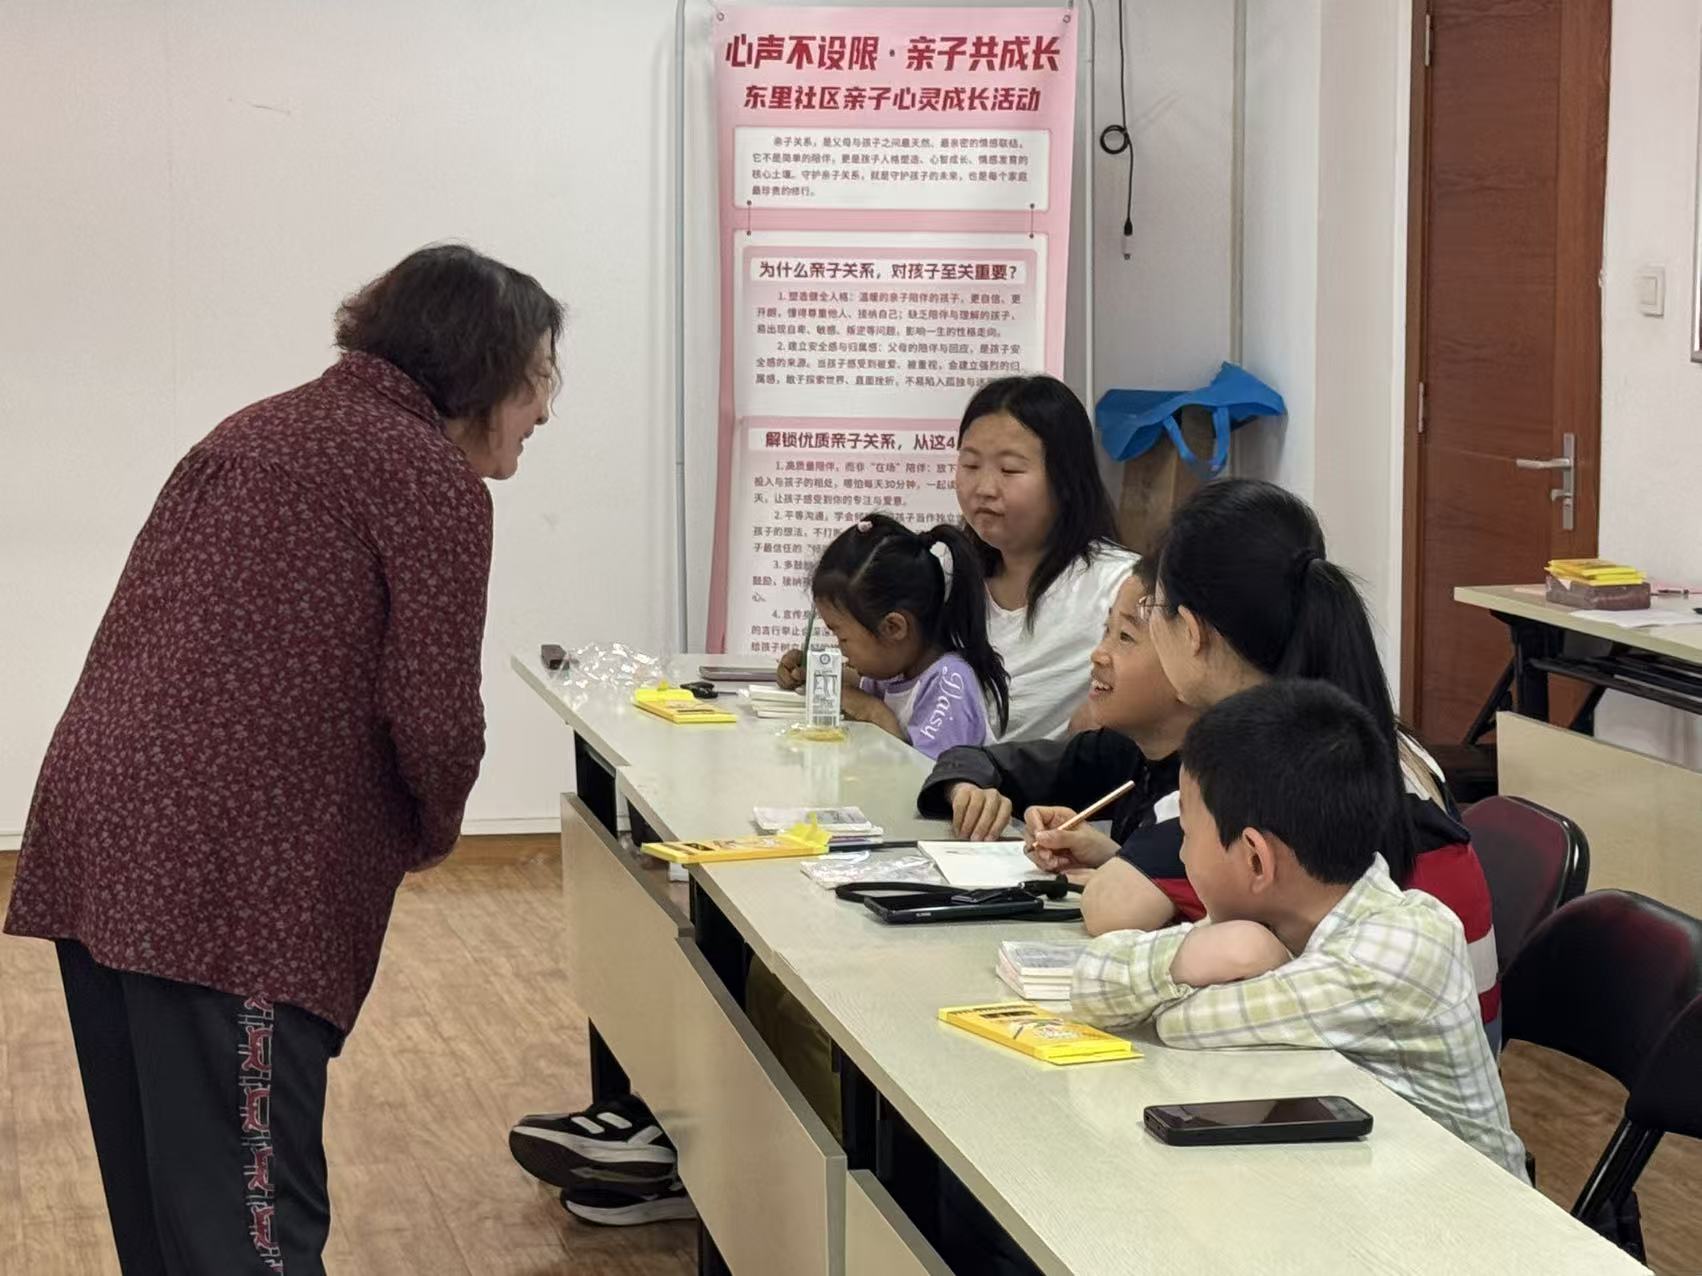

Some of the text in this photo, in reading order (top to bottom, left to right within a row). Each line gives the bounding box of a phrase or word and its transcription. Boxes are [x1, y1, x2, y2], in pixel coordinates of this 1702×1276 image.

[726, 33, 1061, 72] 心声不设限·亲子共成长
[743, 85, 1041, 112] 东里社区亲子心灵成长活动
[752, 185, 815, 197] 最珍贵的修行。
[759, 261, 1018, 281] 为什么亲子关系，对孩子至关重要？
[919, 664, 965, 741] Daisy
